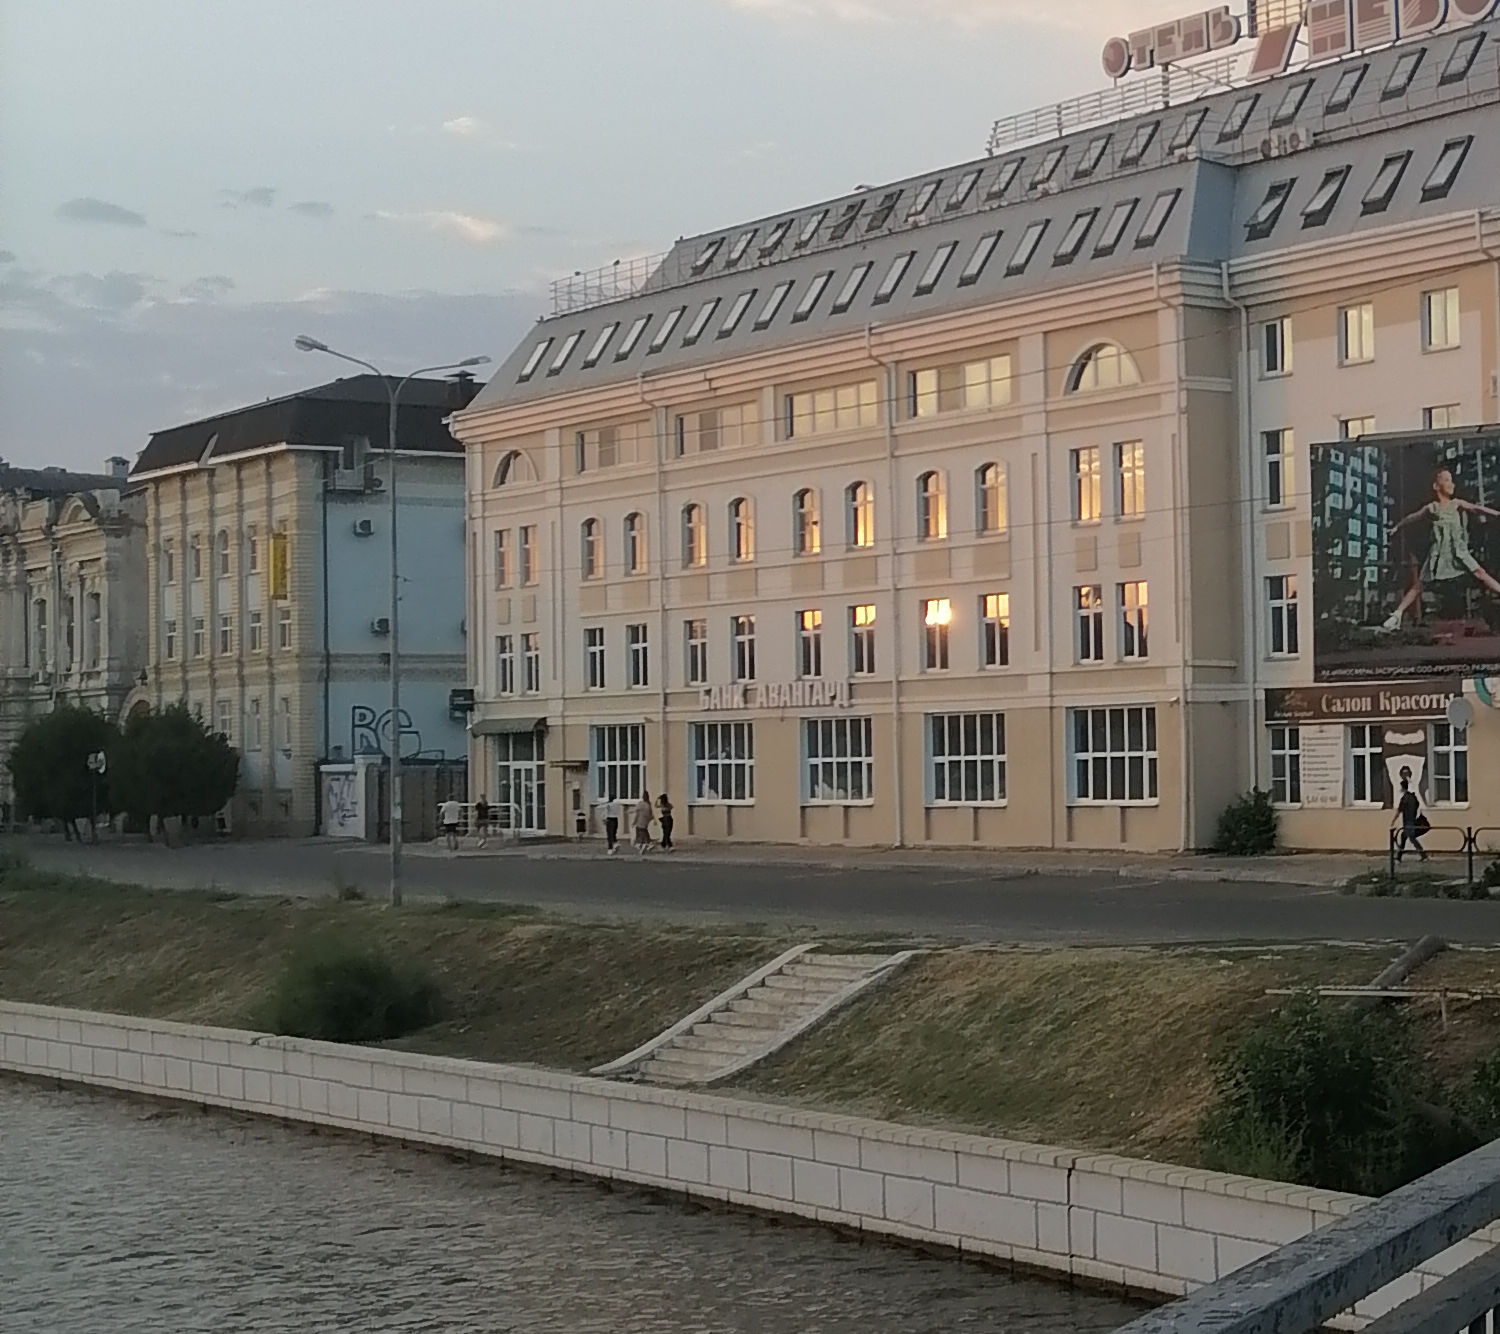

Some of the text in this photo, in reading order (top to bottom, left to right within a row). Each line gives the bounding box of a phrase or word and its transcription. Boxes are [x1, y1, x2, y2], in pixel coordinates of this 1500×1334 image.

[1102, 5, 1241, 78] ОТЕЛЬ
[700, 681, 851, 709] БАНК АВАНГАРД
[1321, 691, 1455, 715] Салон Красоты
